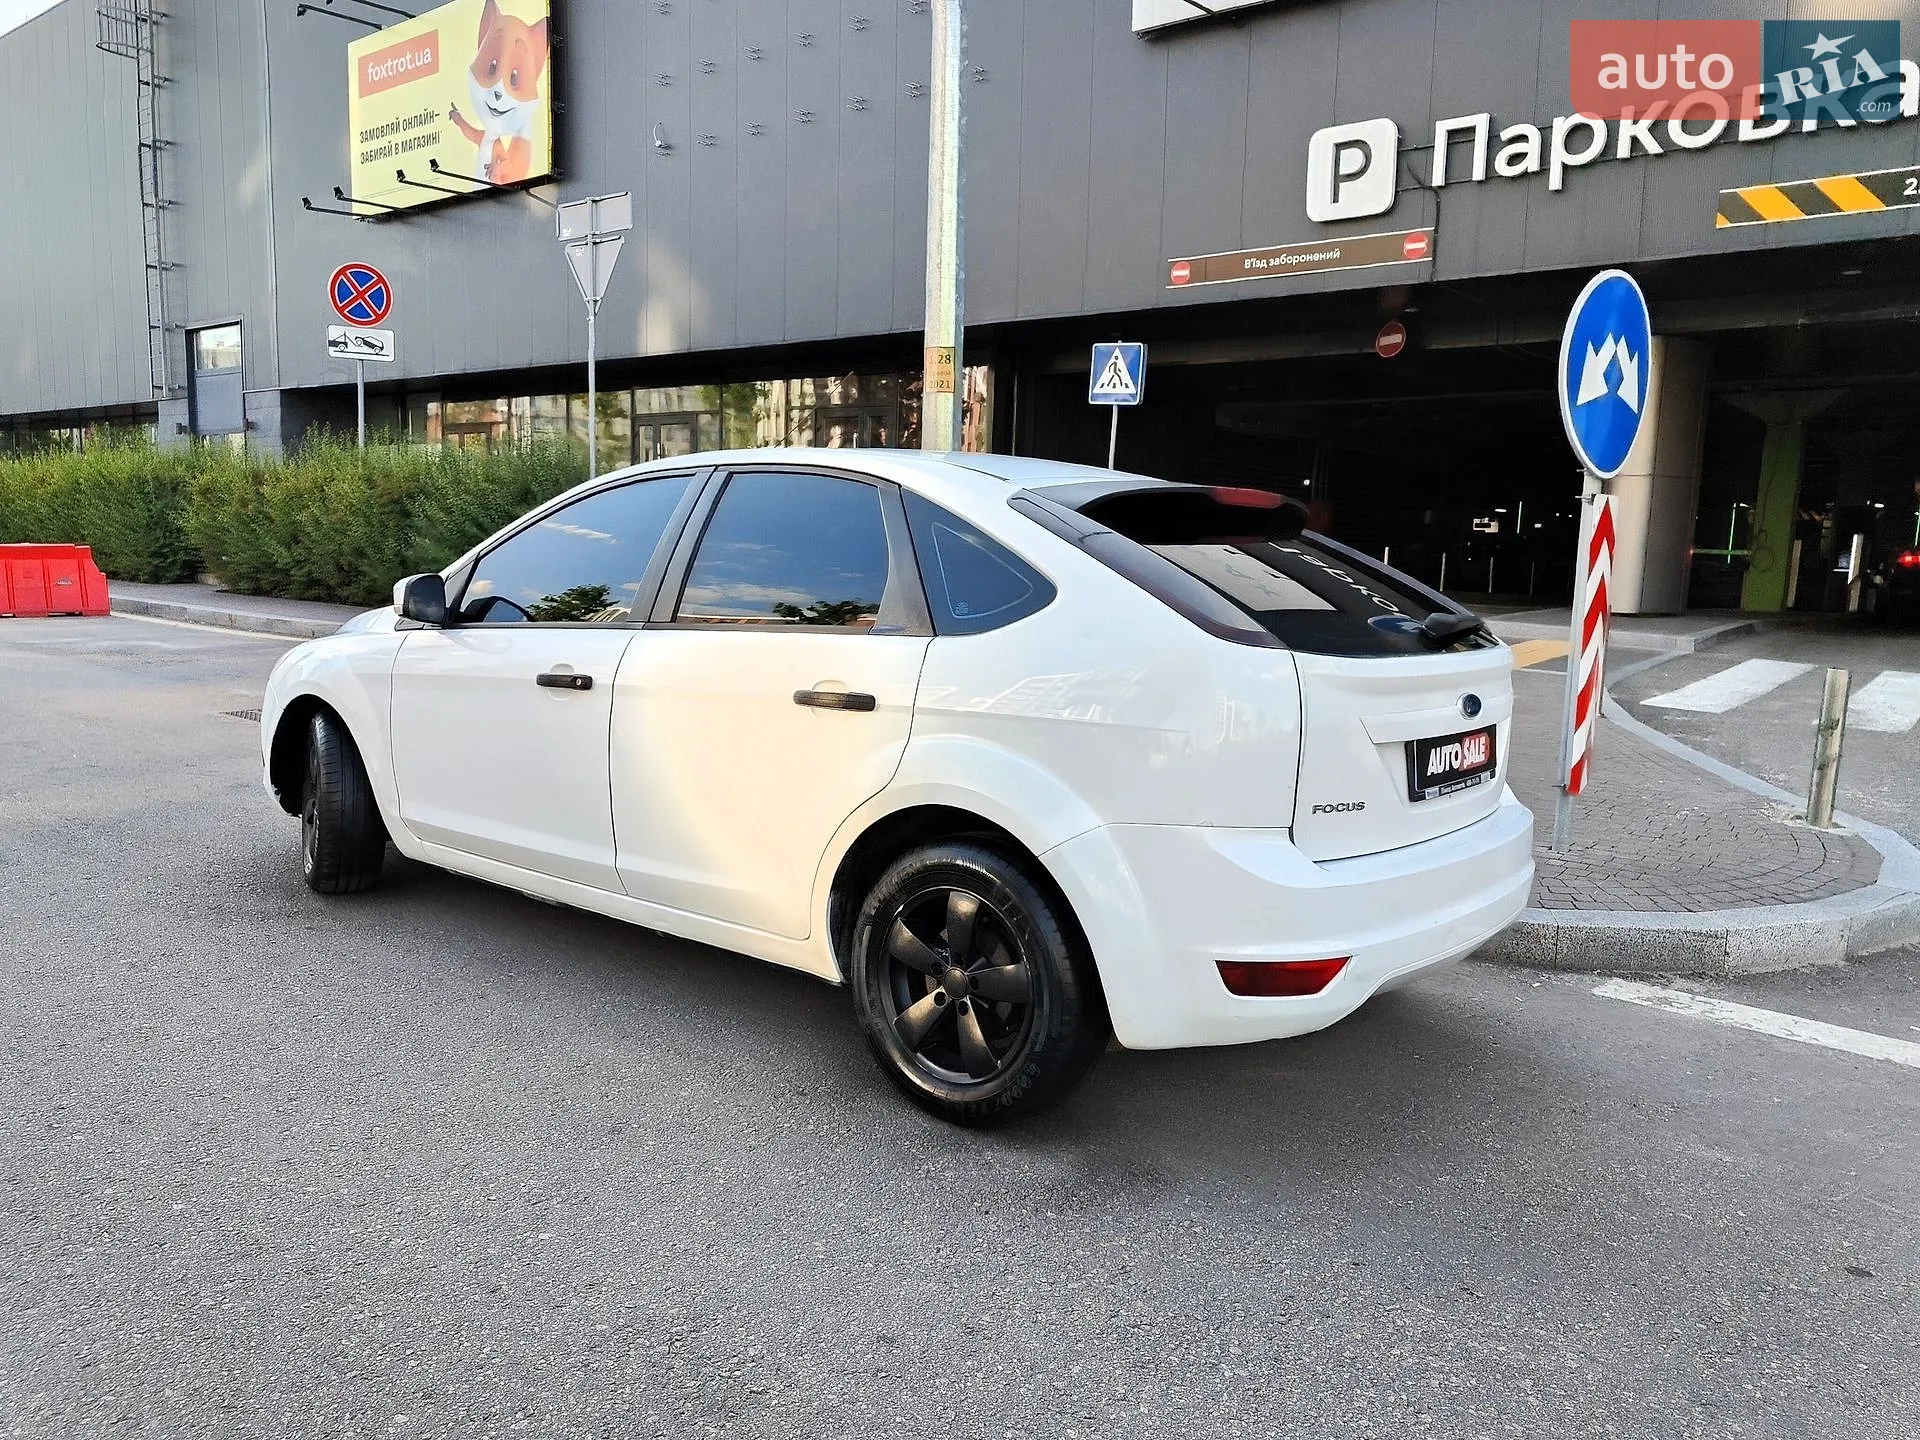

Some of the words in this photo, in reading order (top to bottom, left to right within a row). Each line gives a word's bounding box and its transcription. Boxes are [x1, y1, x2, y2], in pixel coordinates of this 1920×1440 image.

[367, 47, 432, 83] foxtrot.ua
[359, 116, 401, 144] ЗАМОВЛЯЙ
[360, 141, 393, 165] ЗАБИРАЙ
[394, 143, 399, 155] В
[1330, 139, 1373, 204] P
[1268, 248, 1341, 268] заборонений
[1427, 742, 1462, 776] AUTO
[1311, 801, 1366, 815] FOCUS
